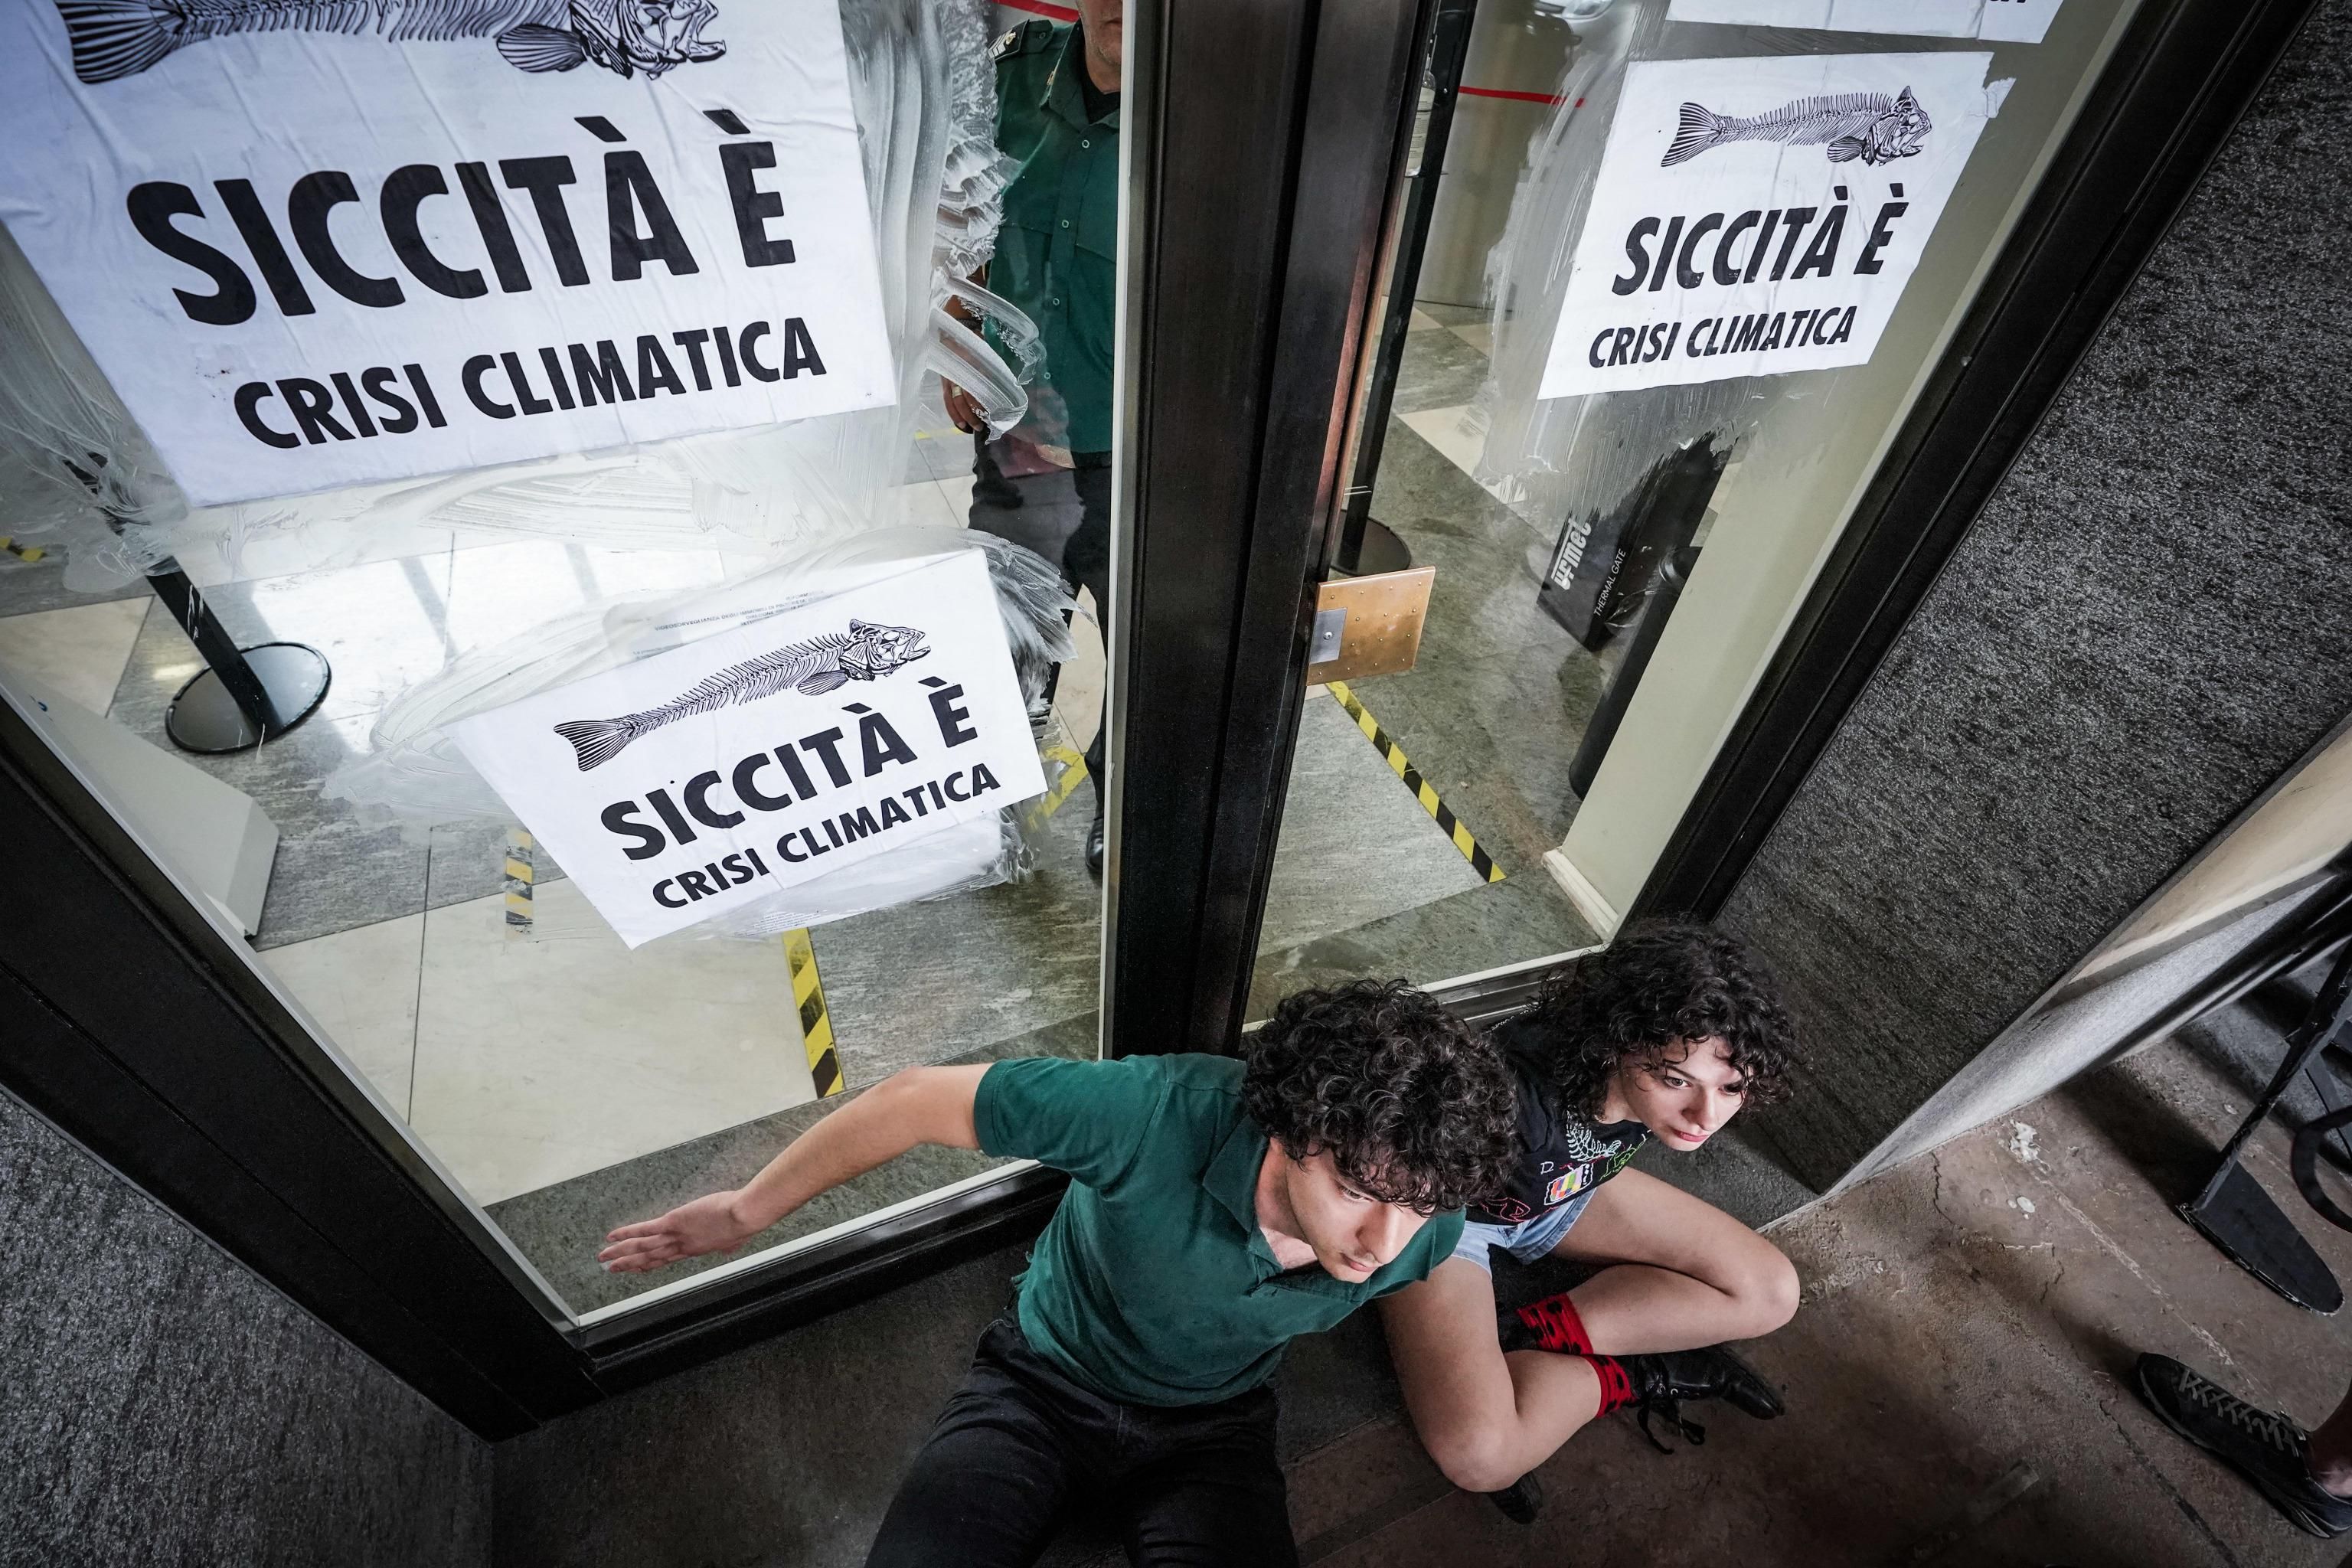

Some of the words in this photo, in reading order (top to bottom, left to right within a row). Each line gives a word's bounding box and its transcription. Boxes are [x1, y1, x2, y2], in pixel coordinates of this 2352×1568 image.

[126, 116, 699, 325] SICCITÀ
[703, 109, 795, 267] È
[1612, 186, 1848, 296] SICCITÀ
[1854, 183, 1909, 274] È
[234, 364, 447, 449] CRISI
[462, 318, 826, 419] CLIMATICA
[1589, 322, 1681, 368] CRISI
[1687, 306, 1857, 357] CLIMATICA
[1593, 576, 1616, 616] THERMAL
[1612, 548, 1626, 575] GATE
[601, 703, 917, 860] SICCITÀ
[919, 677, 978, 747] È
[653, 848, 769, 908] CRISI
[777, 763, 1001, 862] CLIMATICA
